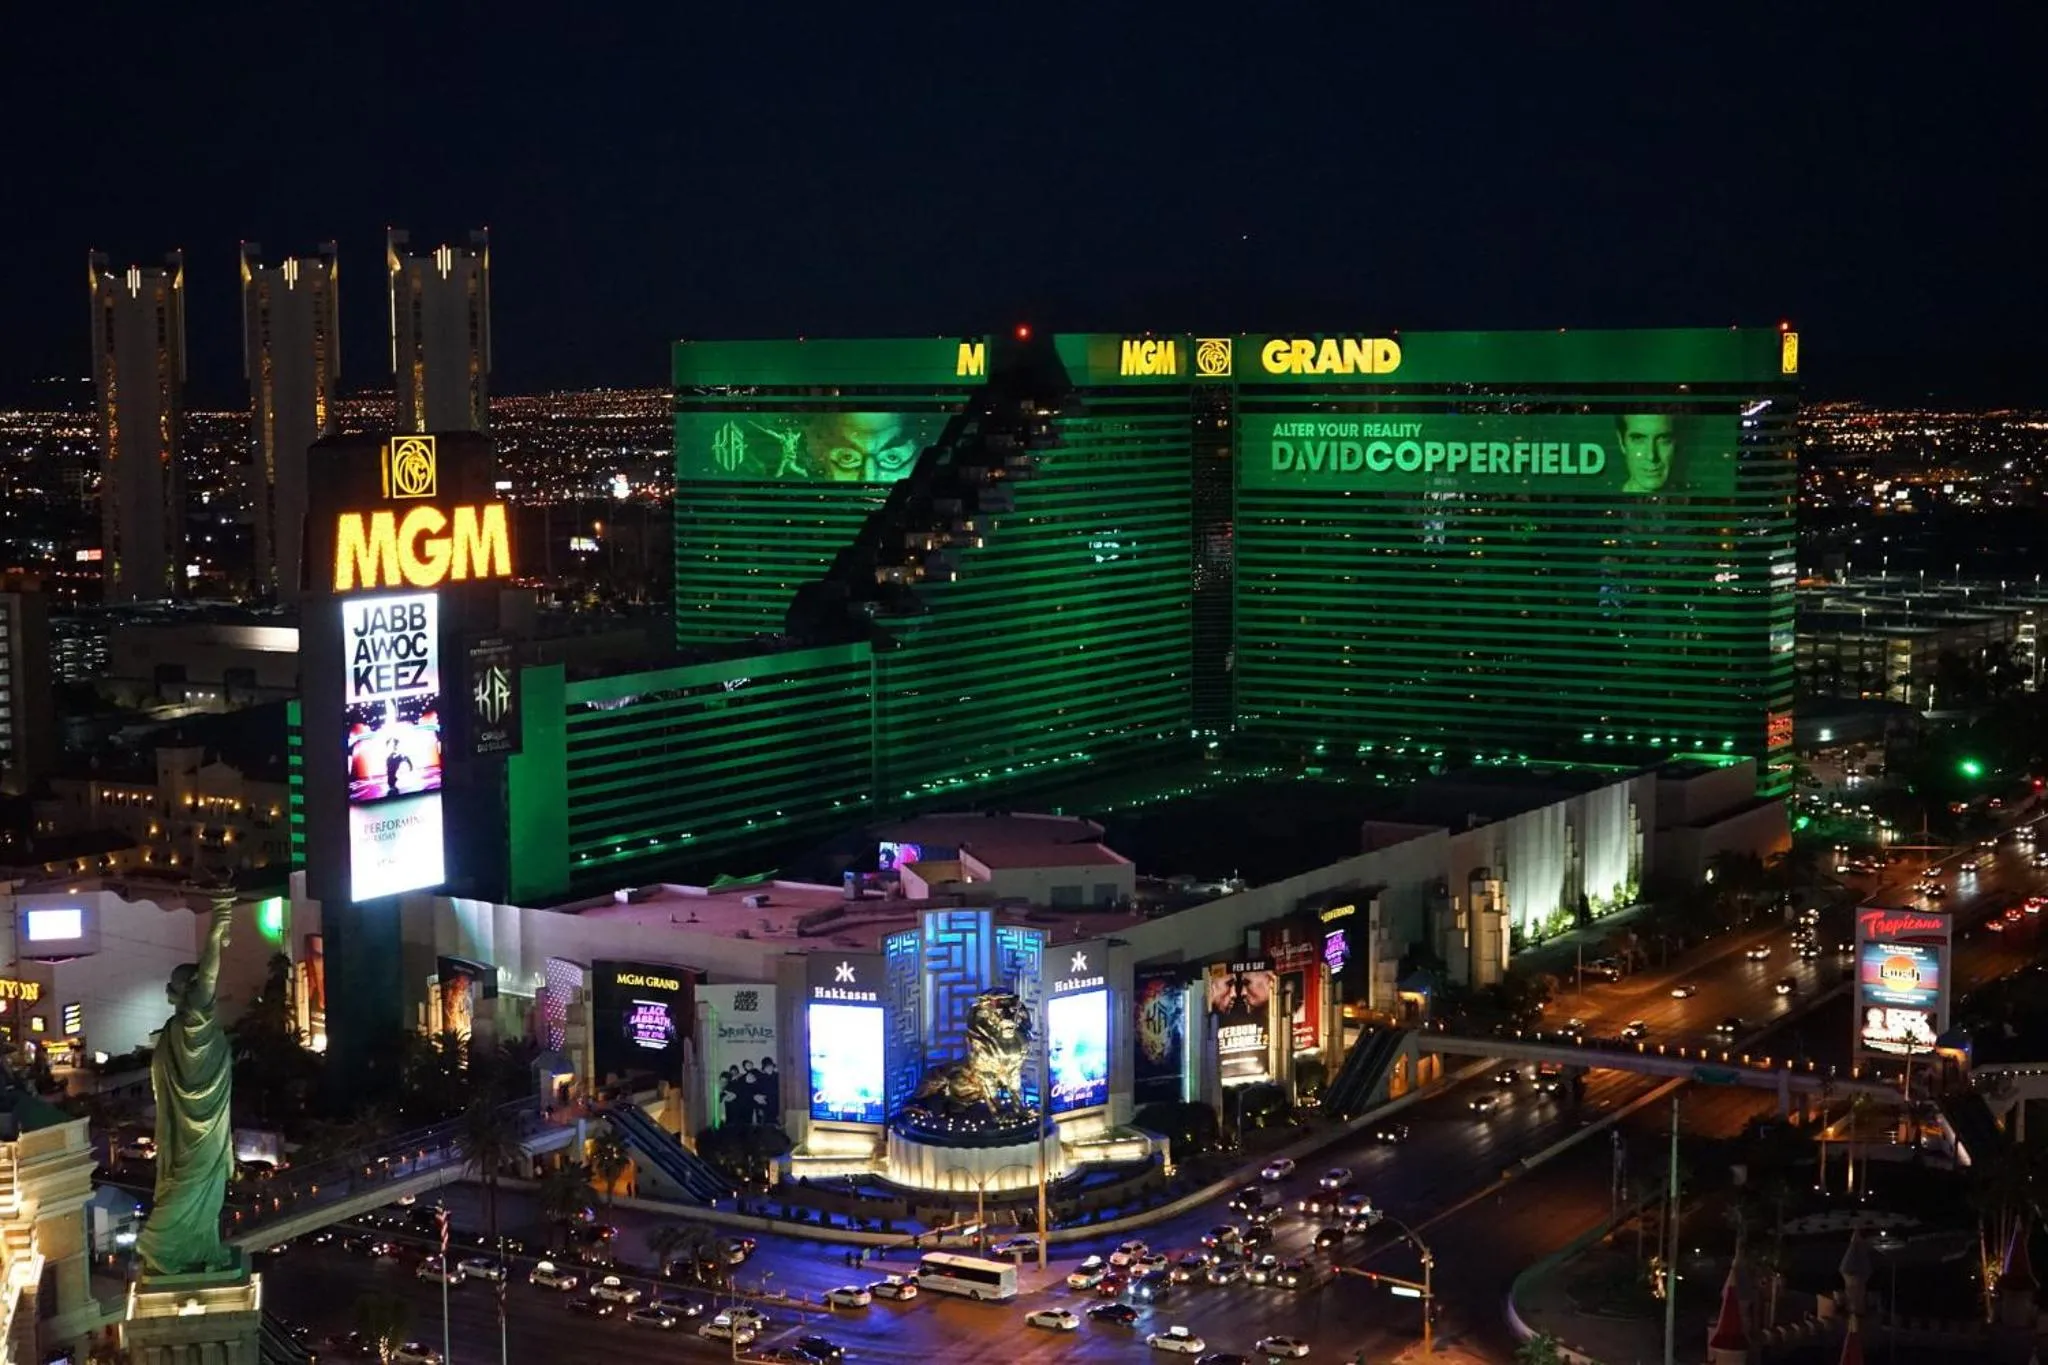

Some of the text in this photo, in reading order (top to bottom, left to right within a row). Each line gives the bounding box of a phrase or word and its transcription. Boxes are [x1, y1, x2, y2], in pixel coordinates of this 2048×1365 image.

[1121, 340, 1177, 376] MGM
[1261, 338, 1401, 374] GRAND
[1273, 423, 1423, 437] ALTER YOUR REALITY
[333, 503, 512, 592] MGM
[353, 603, 428, 638] JABB
[354, 632, 428, 666] AWOC
[353, 659, 429, 697] KEEZ
[1860, 911, 1943, 939] Tropicana
[617, 973, 679, 991] MGM GRAND
[814, 986, 877, 1001] Hakkasan
[1054, 976, 1104, 992] Hakkasan
